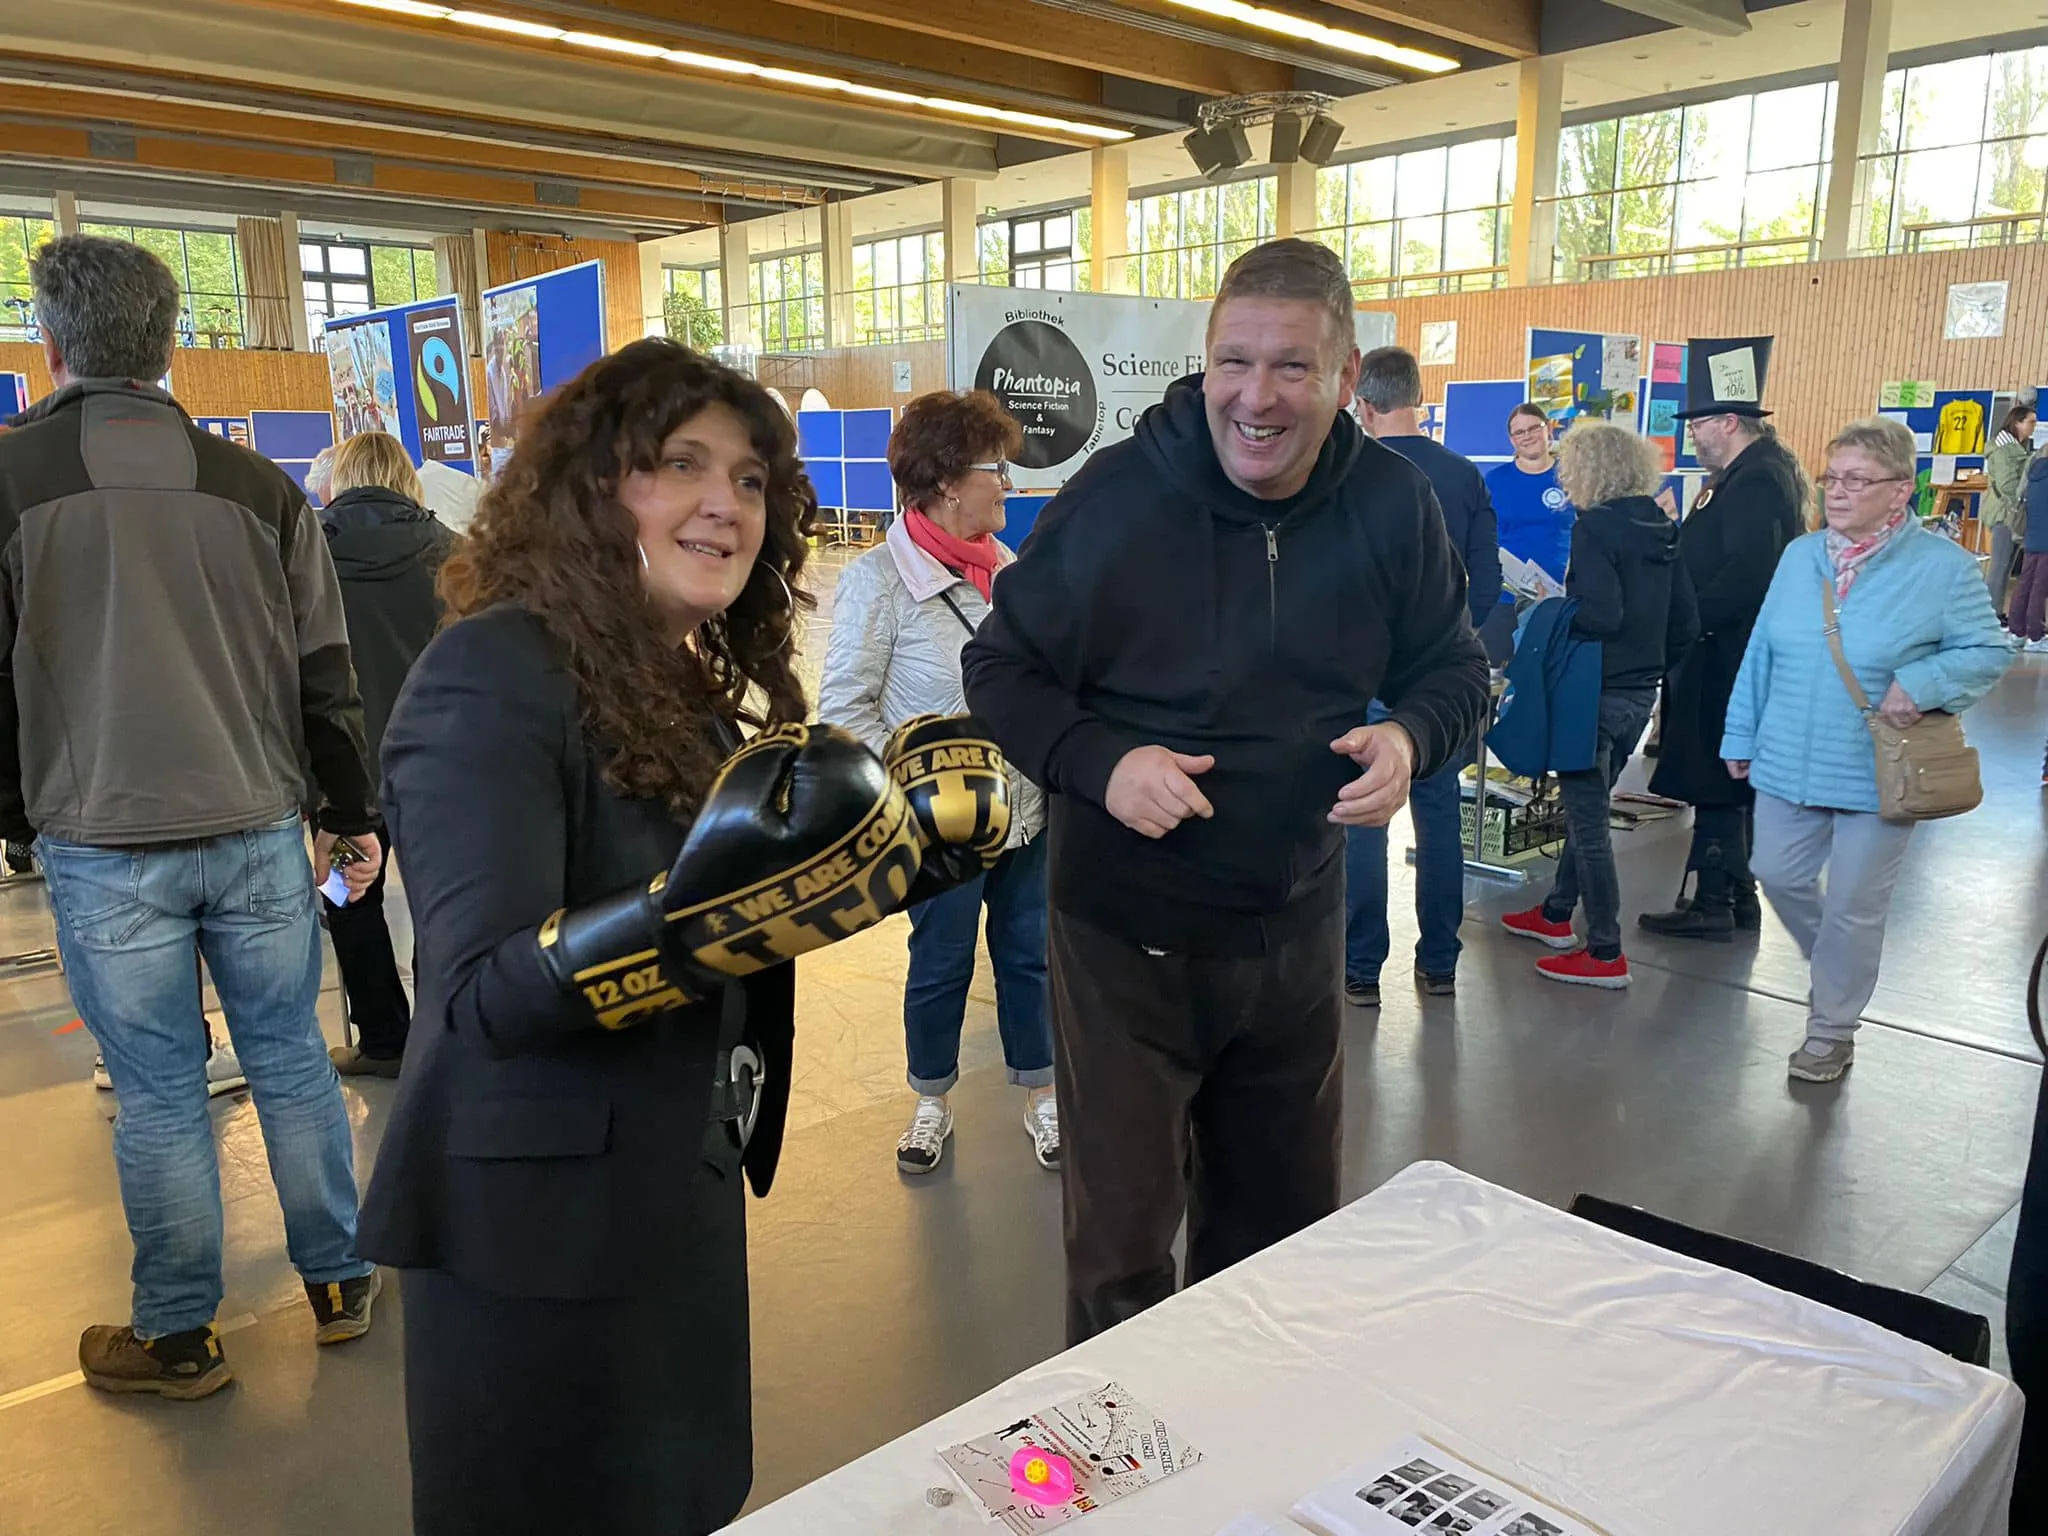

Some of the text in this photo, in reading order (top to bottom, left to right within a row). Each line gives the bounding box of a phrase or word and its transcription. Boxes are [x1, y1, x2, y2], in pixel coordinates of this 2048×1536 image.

[1005, 309, 1064, 326] Bibliothek
[1102, 353, 1179, 377] Science
[993, 367, 1080, 398] Phantopia
[1008, 400, 1069, 411] Science Fiction
[1036, 413, 1043, 422] &
[423, 424, 466, 442] FAIRTRADE
[1023, 425, 1056, 437] Fantasy
[1082, 401, 1107, 455] Tabletop
[931, 746, 986, 771] ARE
[730, 887, 793, 922] WE
[793, 849, 859, 900] ARE
[583, 964, 668, 1009] 12 OZ
[1140, 1433, 1156, 1460] DICH!
[1153, 1419, 1175, 1475] WIR SUCHEN
